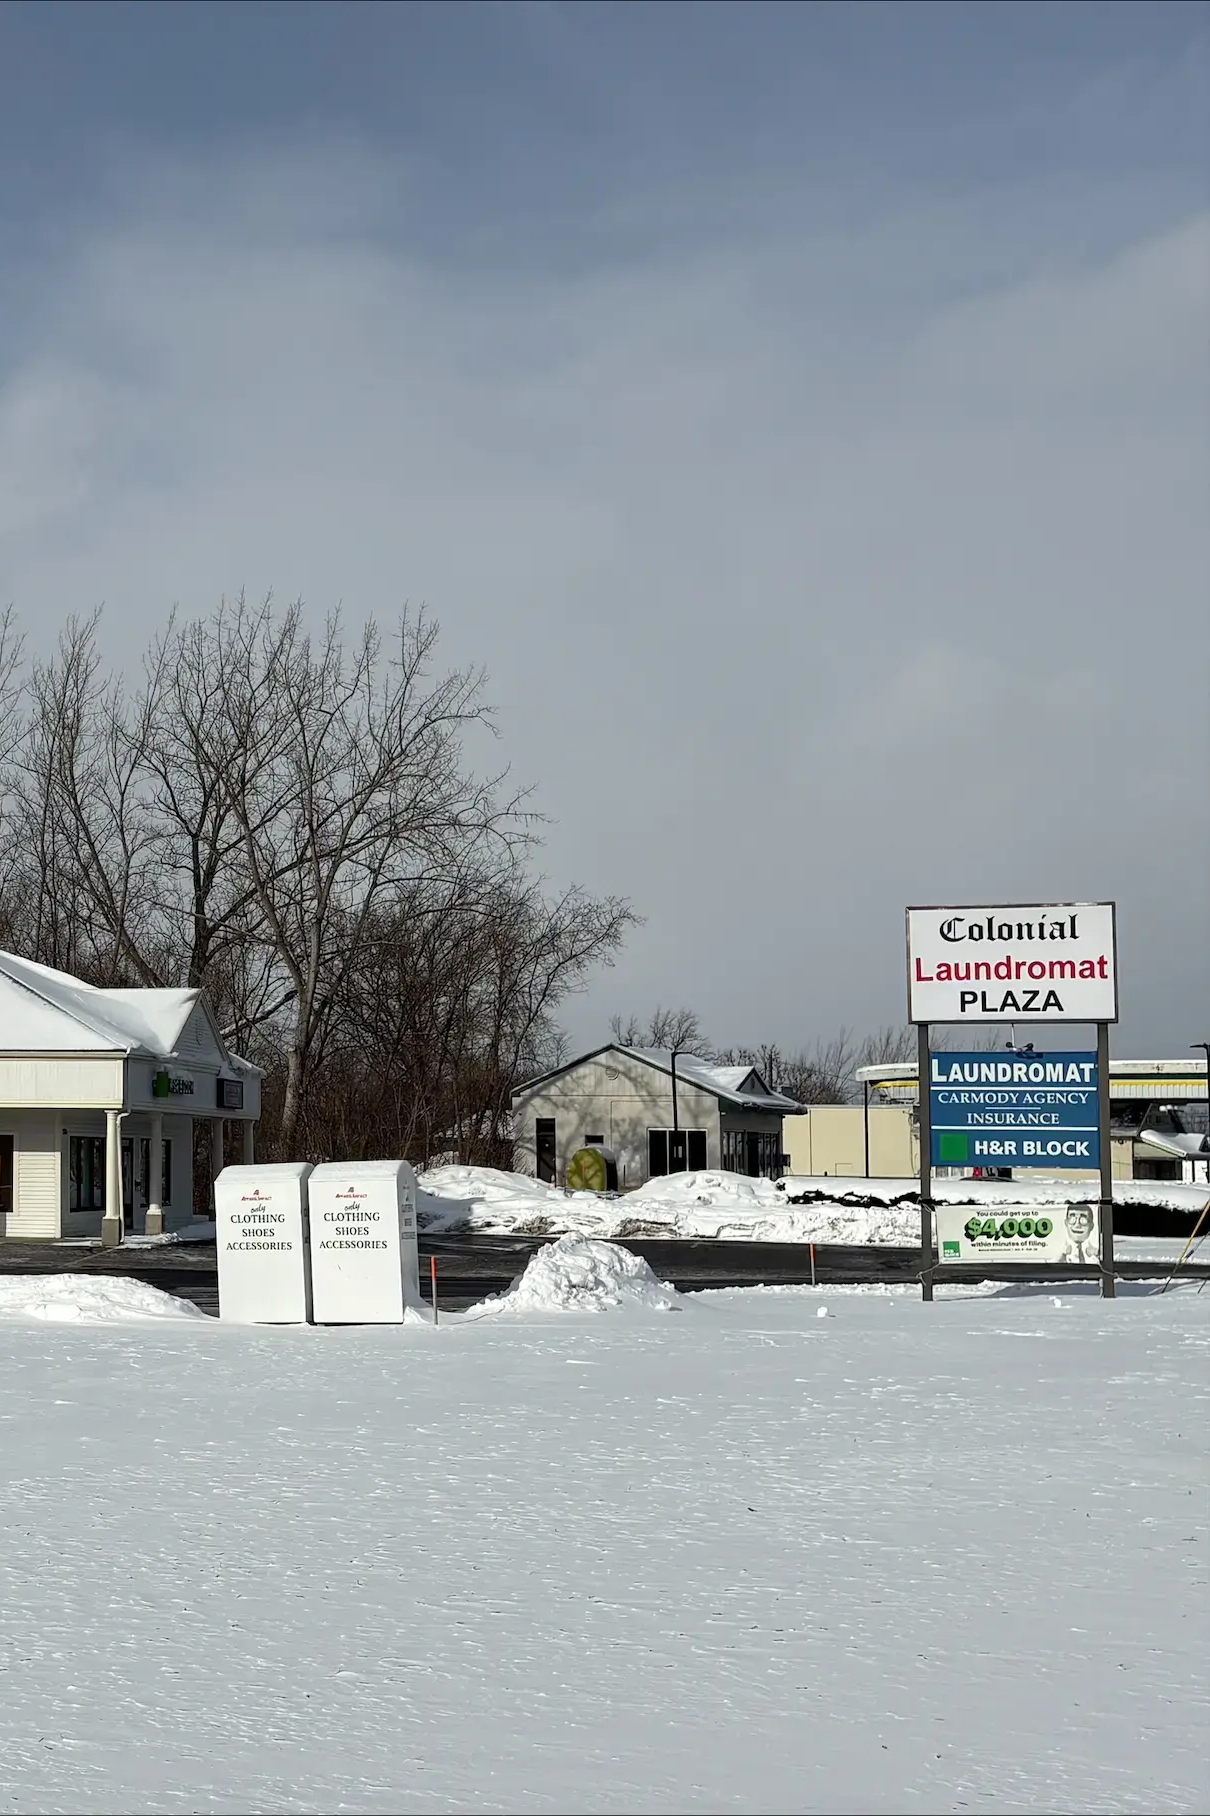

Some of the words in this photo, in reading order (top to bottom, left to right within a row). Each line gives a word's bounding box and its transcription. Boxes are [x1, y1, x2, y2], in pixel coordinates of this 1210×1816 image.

[939, 913, 1080, 942] Colonial
[915, 955, 1108, 982] Laundromat
[960, 990, 1064, 1012] PLAZA
[931, 1058, 1095, 1083] LAUNDROMAT
[938, 1092, 1019, 1104] CARMODY
[1022, 1092, 1089, 1104] AGENCY
[967, 1113, 1060, 1124] INSURANCE
[974, 1140, 1017, 1155] H&R
[1023, 1140, 1090, 1156] BLOCK
[250, 1203, 266, 1213] only
[344, 1201, 360, 1211] only
[230, 1214, 285, 1223] CLOTHING
[323, 1212, 380, 1222] CLOTHING
[242, 1228, 275, 1237] SHOES
[335, 1226, 369, 1236] SHOES
[965, 1217, 1053, 1240] $4,000
[226, 1241, 293, 1250] ACCESSORIES
[319, 1240, 388, 1249] ACCESSORIES
